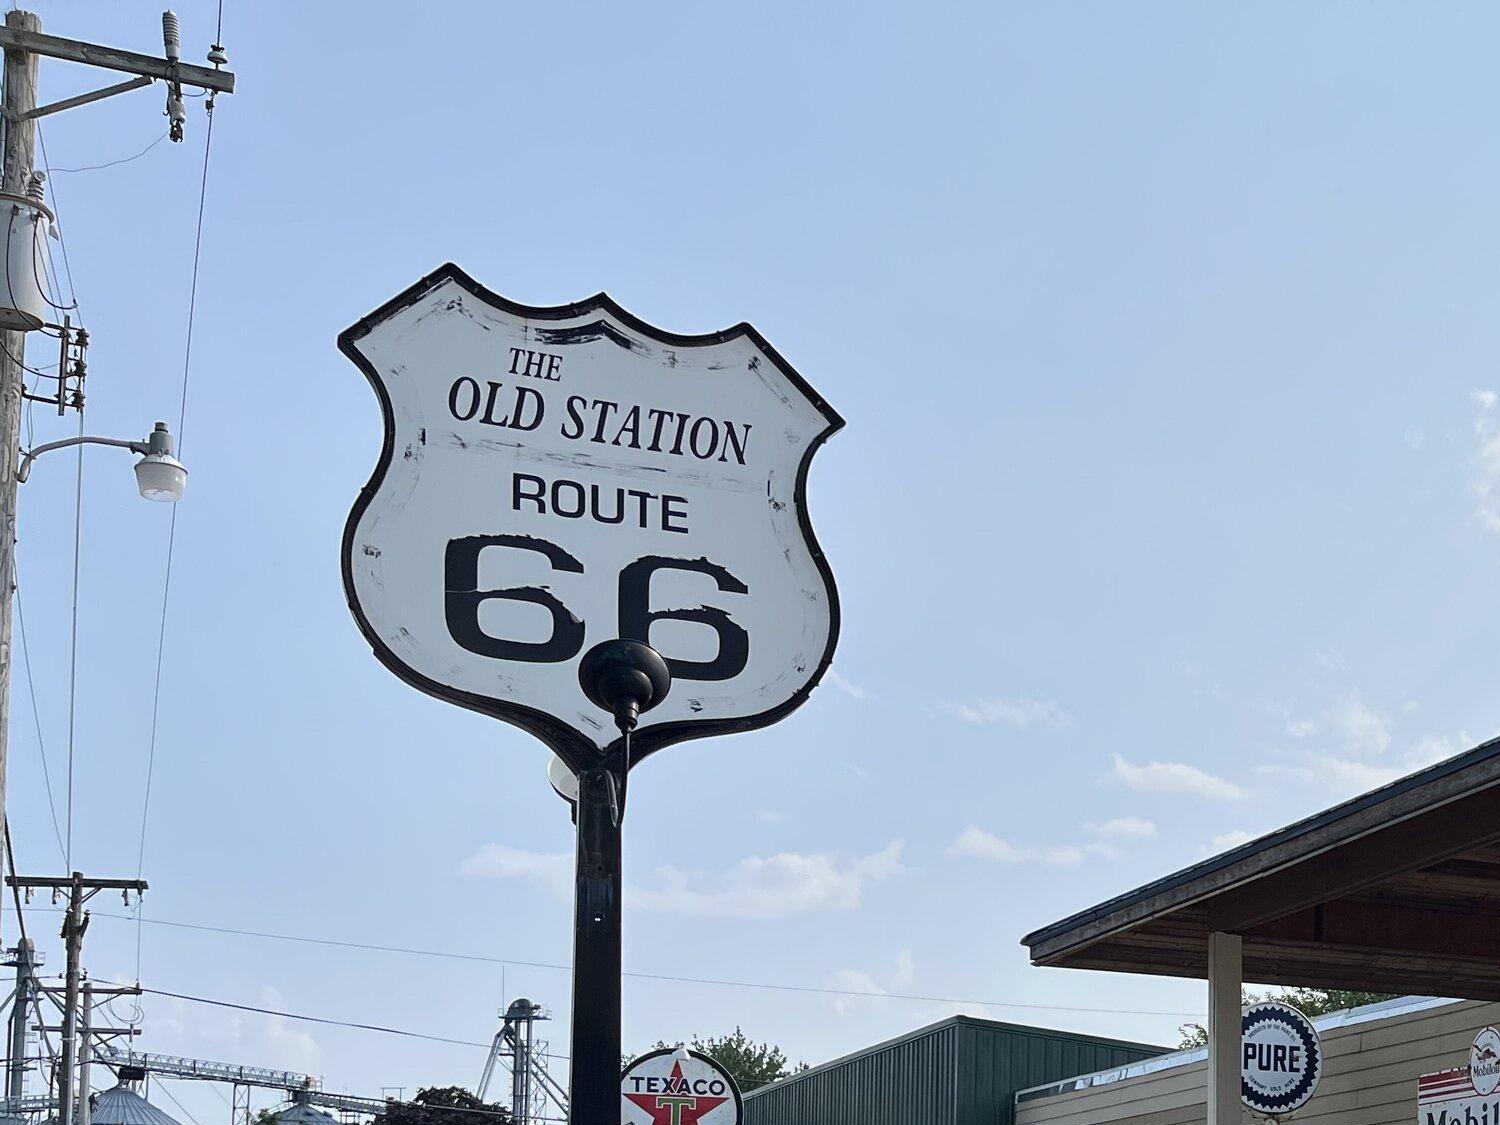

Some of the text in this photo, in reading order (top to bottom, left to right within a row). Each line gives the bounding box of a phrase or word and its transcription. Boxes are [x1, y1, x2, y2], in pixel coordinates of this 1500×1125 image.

[508, 346, 564, 383] THE
[448, 375, 753, 466] OLD STATION
[511, 471, 690, 535] ROUTE
[444, 533, 749, 682] 66
[1243, 1042, 1301, 1073] PURE
[629, 1076, 726, 1096] TEXACO
